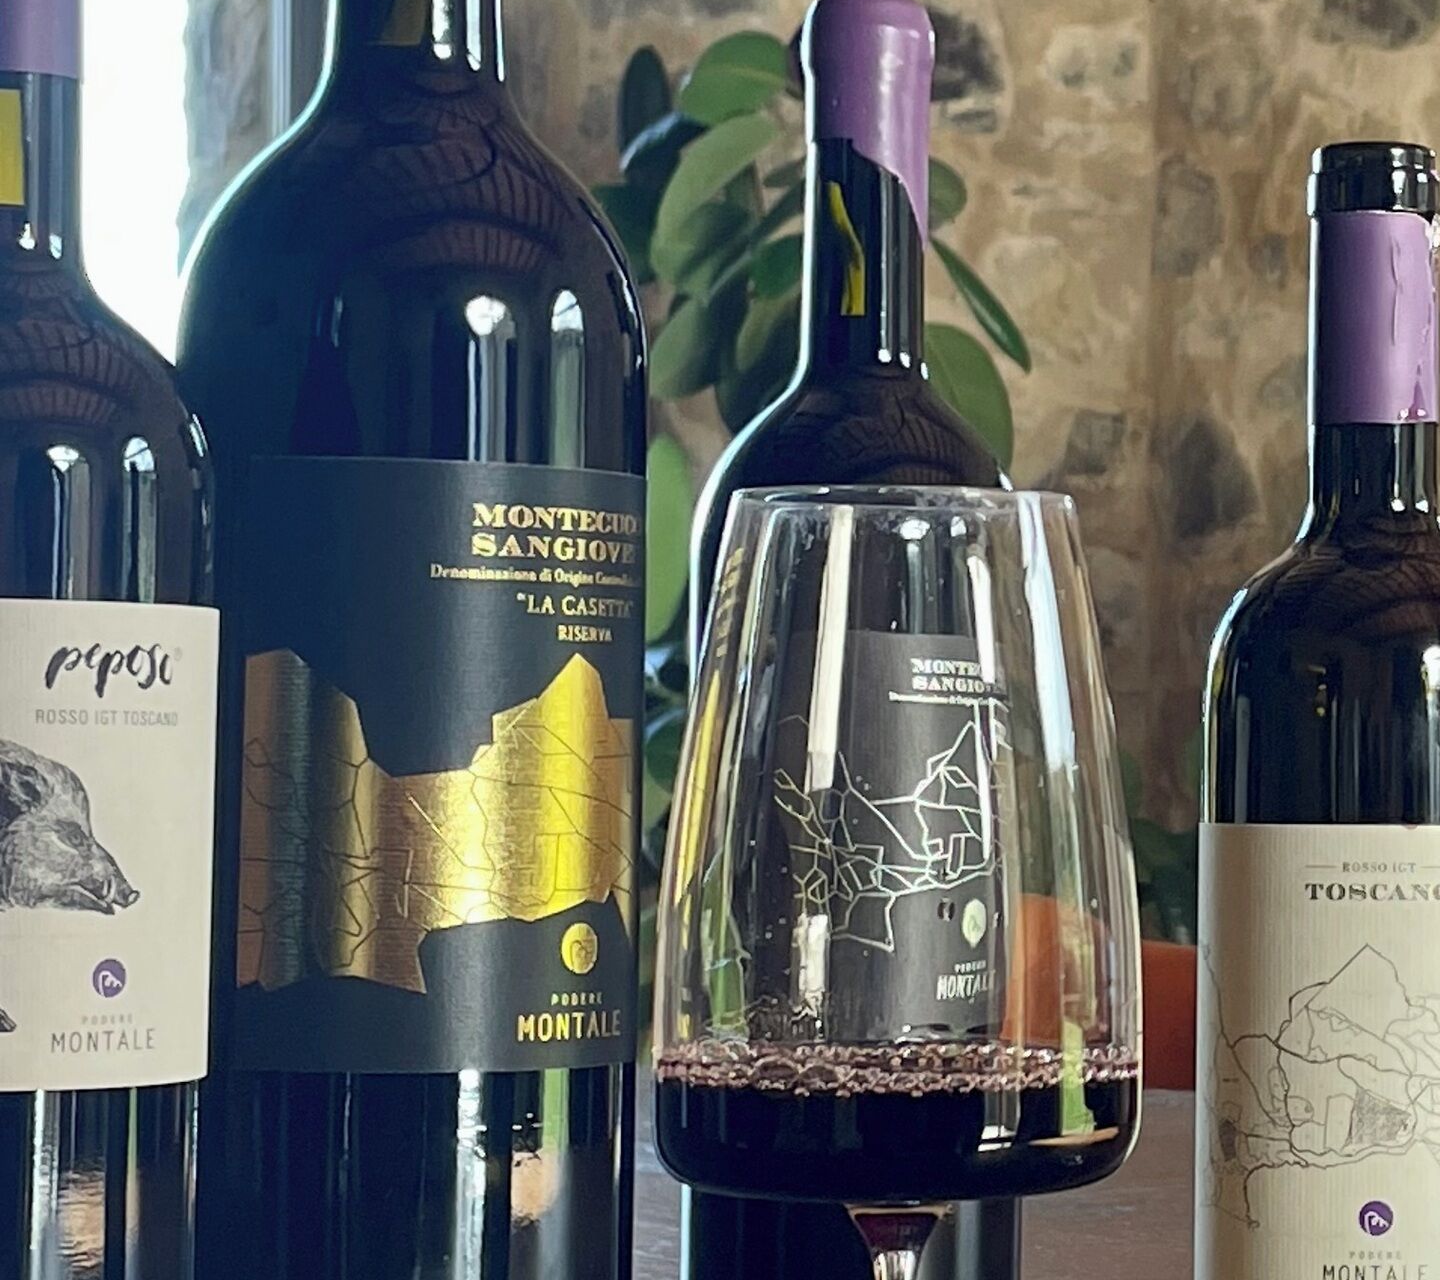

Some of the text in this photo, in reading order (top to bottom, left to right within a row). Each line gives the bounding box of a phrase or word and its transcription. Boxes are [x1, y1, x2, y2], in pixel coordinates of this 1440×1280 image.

[557, 624, 614, 642] RISERVA
[35, 708, 179, 727] ROSSO IGT TOSCANO
[1341, 861, 1417, 874] ROSSO IGT
[551, 991, 603, 1007] PODERE
[81, 1013, 134, 1026] PODERE
[517, 1008, 622, 1042] MONTALE
[50, 1027, 157, 1054] MONTALE
